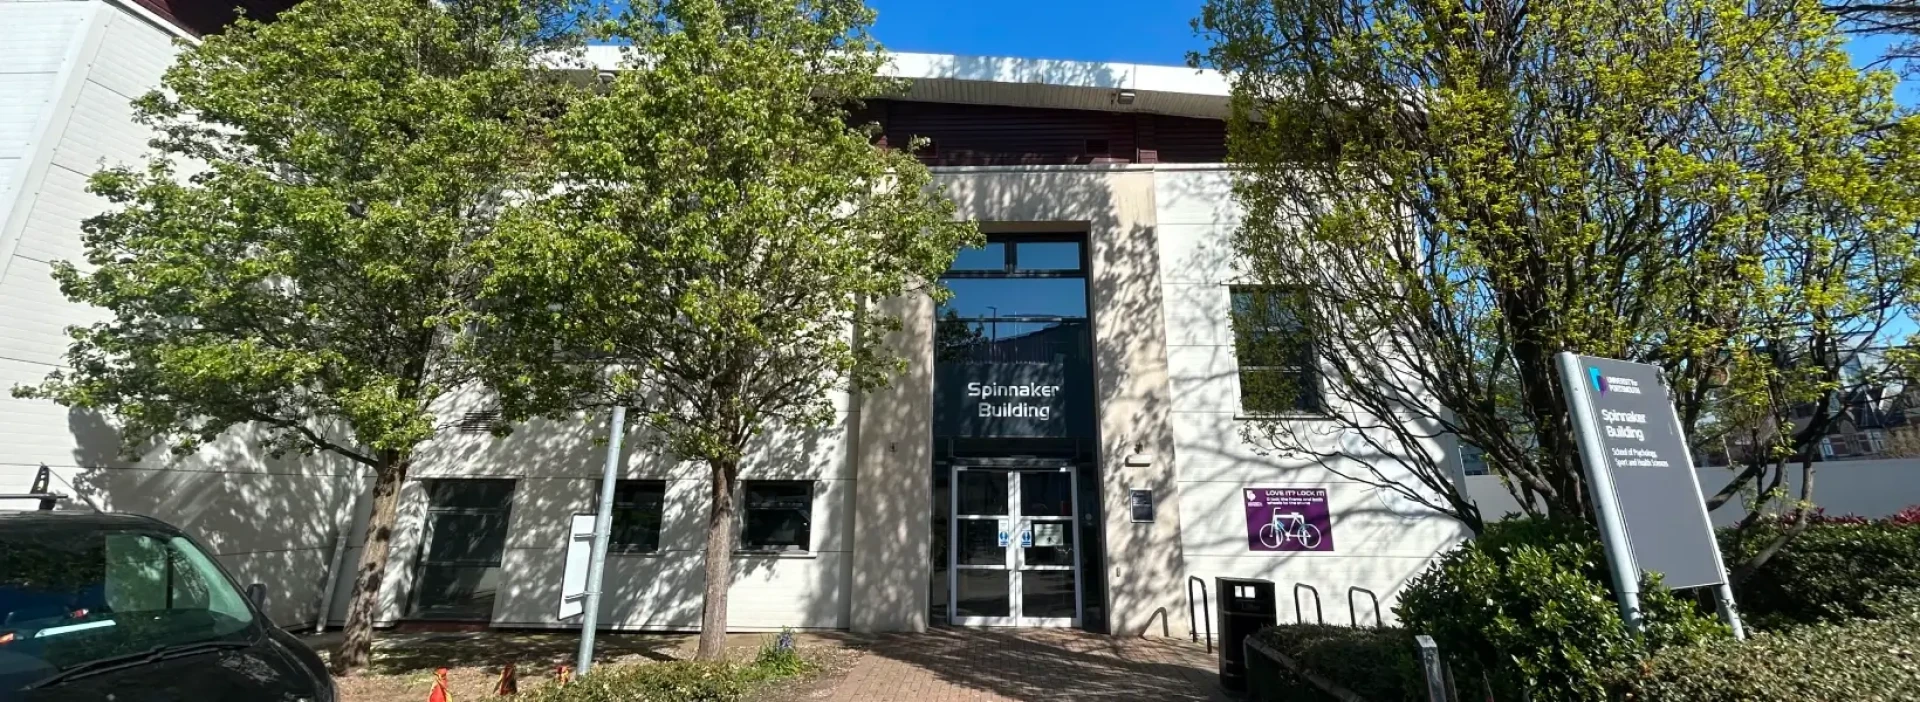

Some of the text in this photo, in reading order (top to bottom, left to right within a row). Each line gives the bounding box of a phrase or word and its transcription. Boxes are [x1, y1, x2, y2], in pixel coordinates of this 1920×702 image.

[967, 382, 1059, 399] Spinnaker
[978, 402, 1050, 421] Building
[1601, 409, 1647, 424] Spinnaker
[1605, 425, 1645, 441] Building
